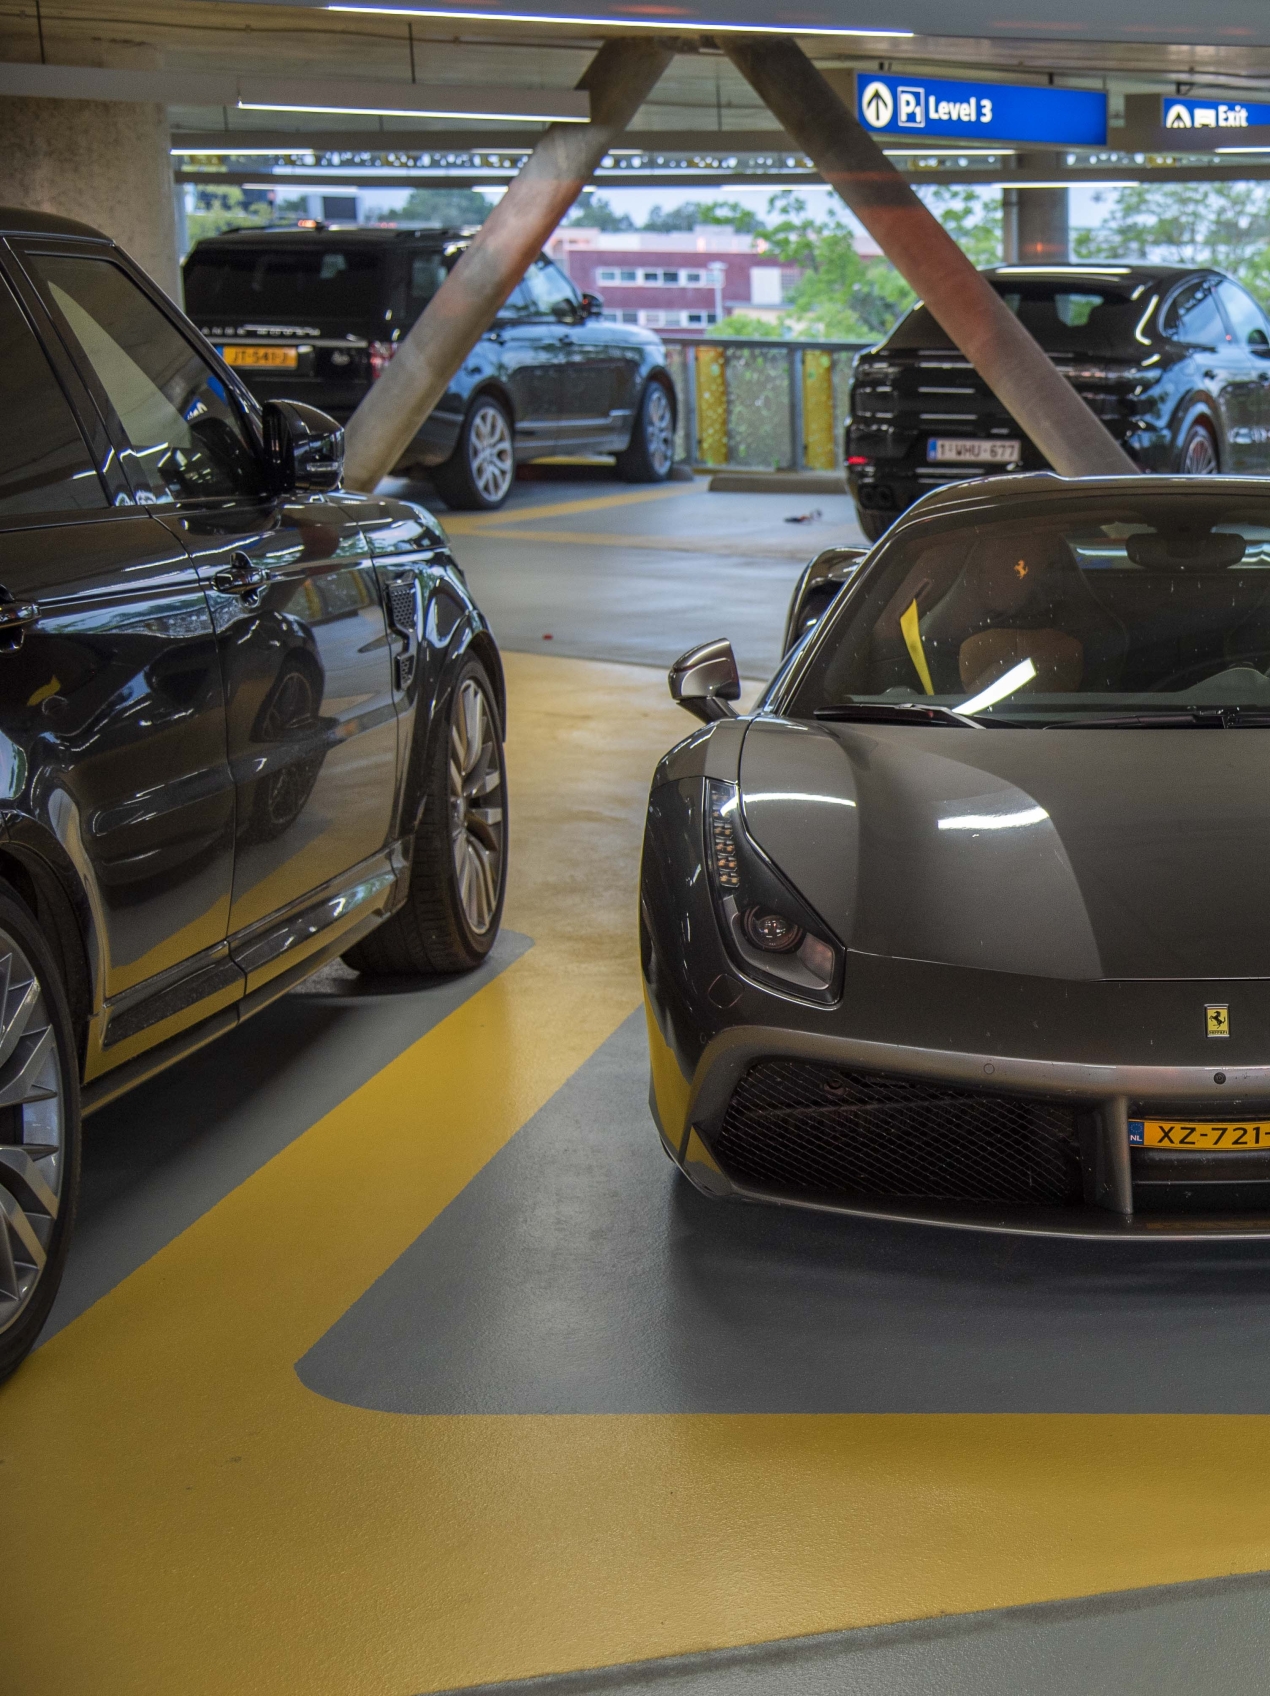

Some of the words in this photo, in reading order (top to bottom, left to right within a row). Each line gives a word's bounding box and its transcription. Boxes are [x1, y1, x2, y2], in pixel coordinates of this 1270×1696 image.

[928, 95, 977, 122] Level
[979, 98, 993, 123] 3
[1217, 105, 1249, 127] Exit
[1130, 1134, 1143, 1142] NL
